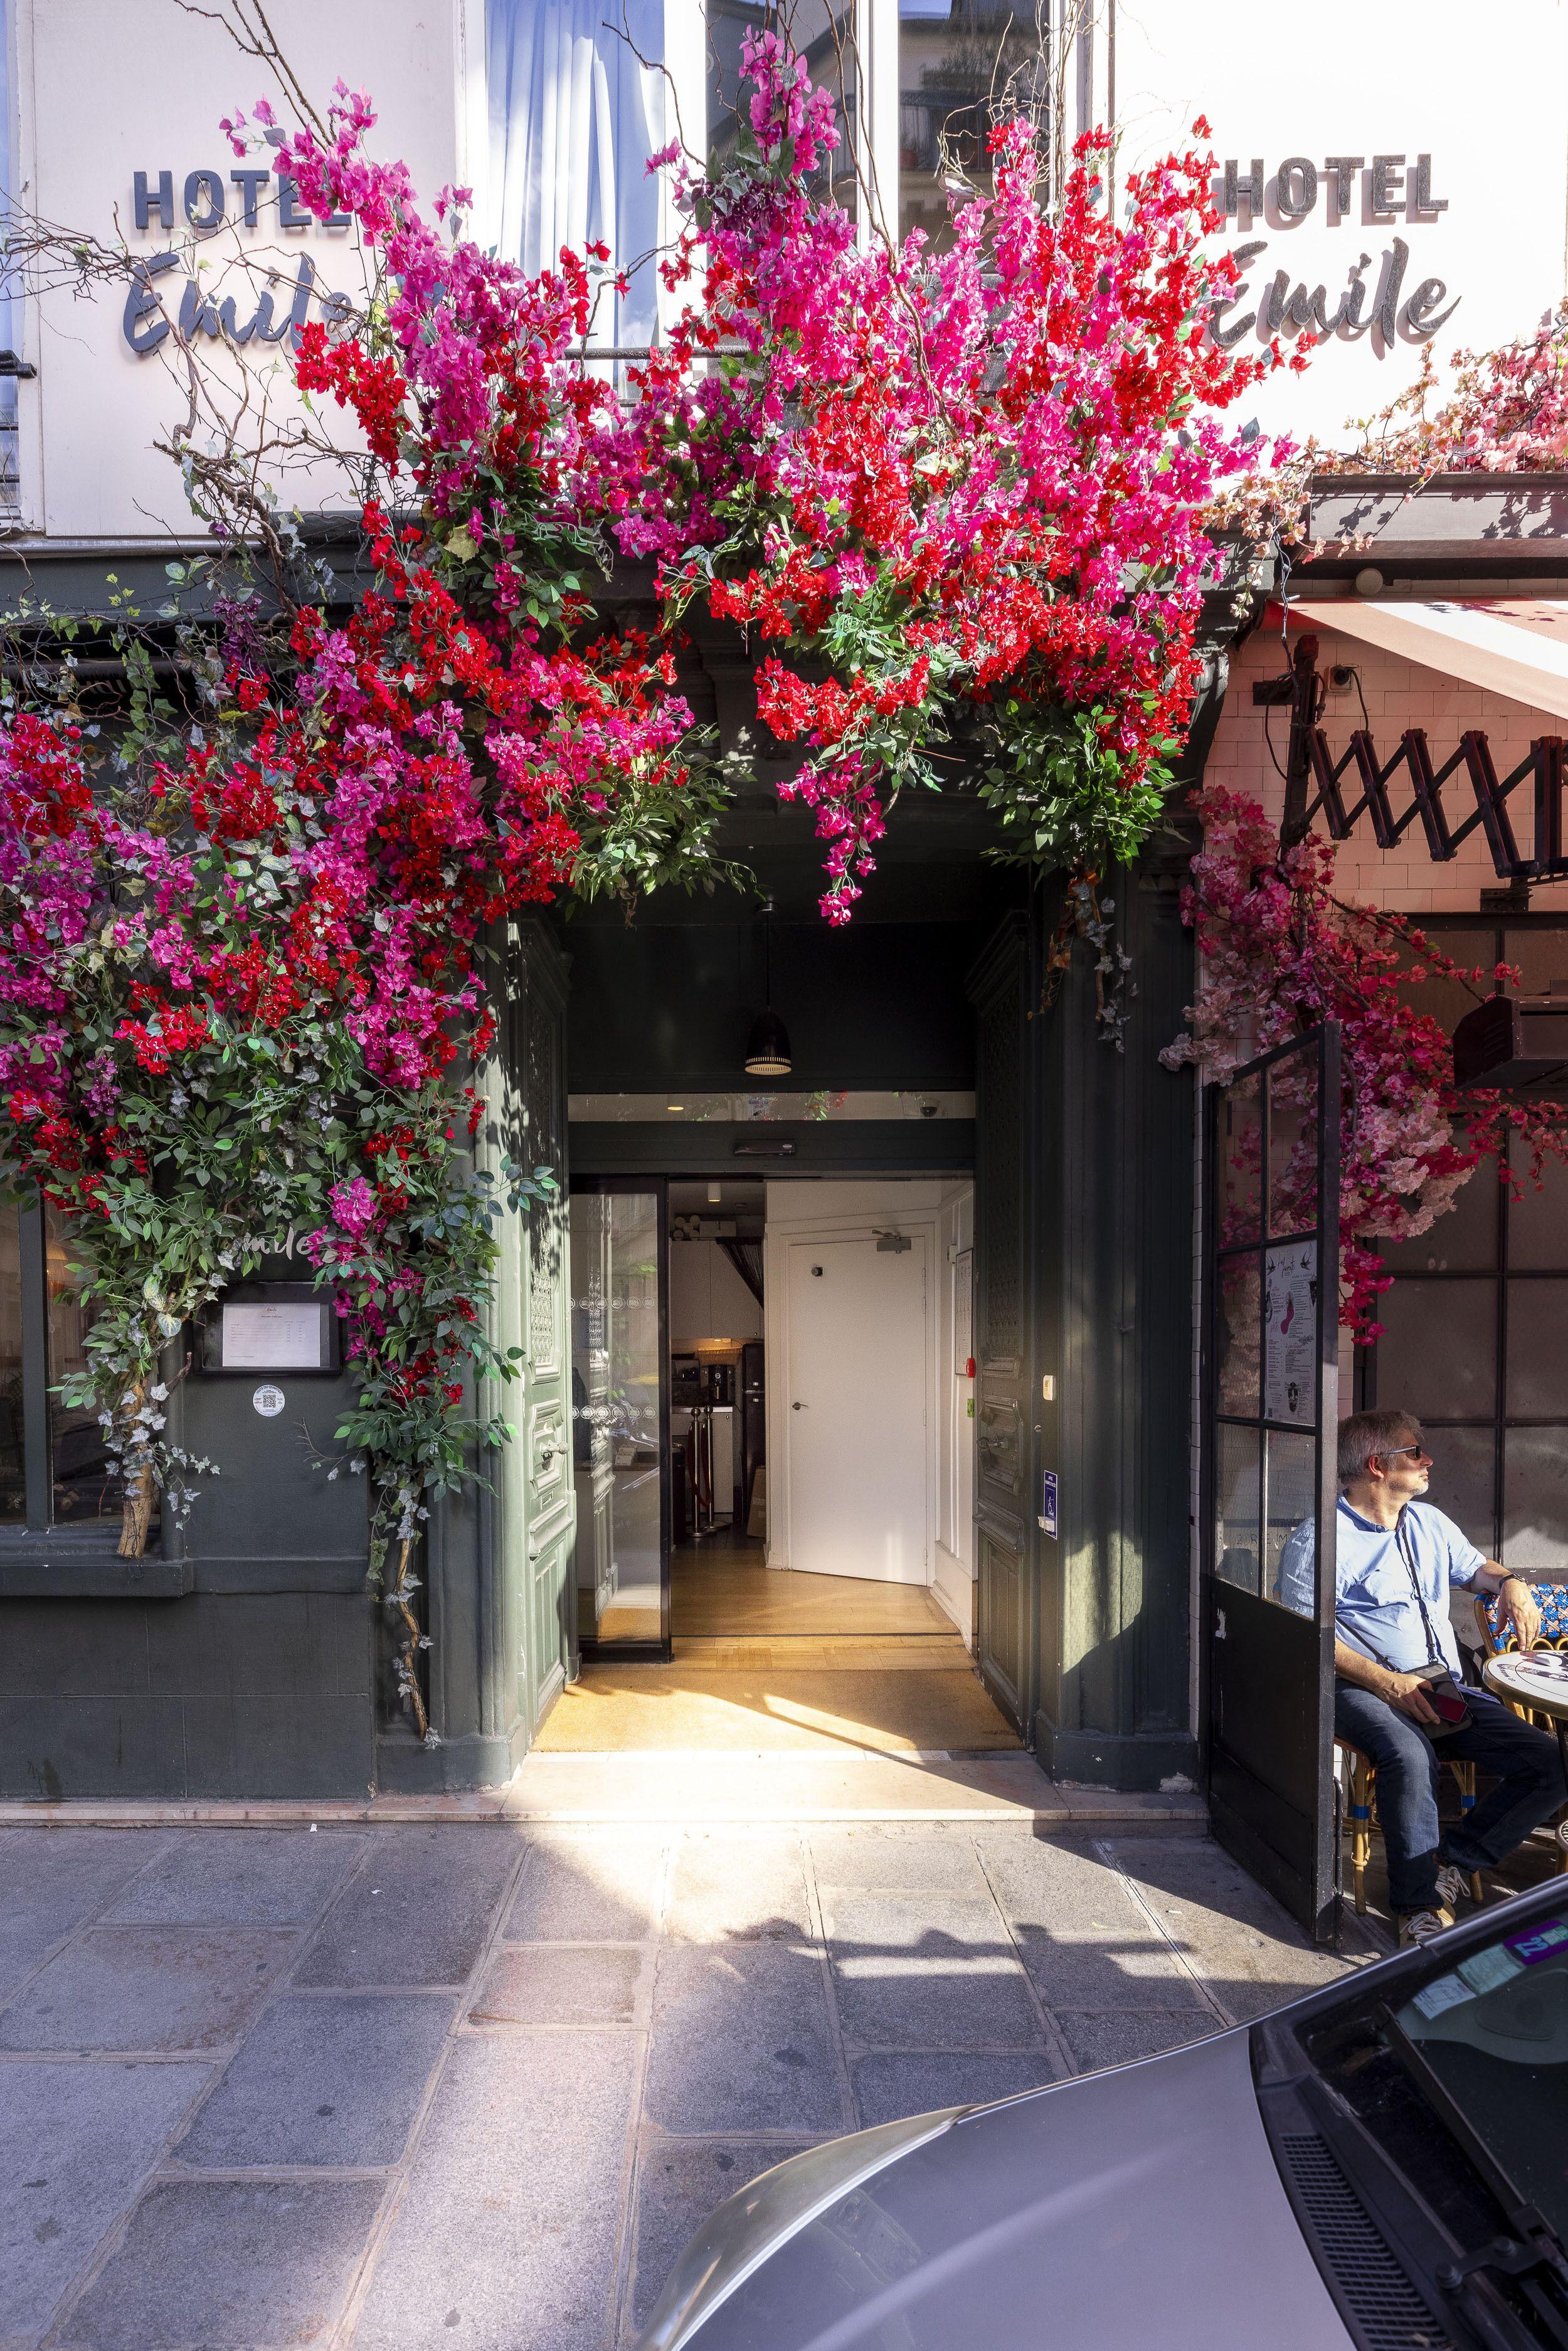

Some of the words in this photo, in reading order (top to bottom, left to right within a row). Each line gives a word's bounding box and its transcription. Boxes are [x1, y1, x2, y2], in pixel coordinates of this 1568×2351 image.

[1224, 154, 1449, 217] HOTEL
[124, 252, 361, 353] Emile
[1209, 236, 1462, 349] Emile
[241, 1226, 313, 1260] mile
